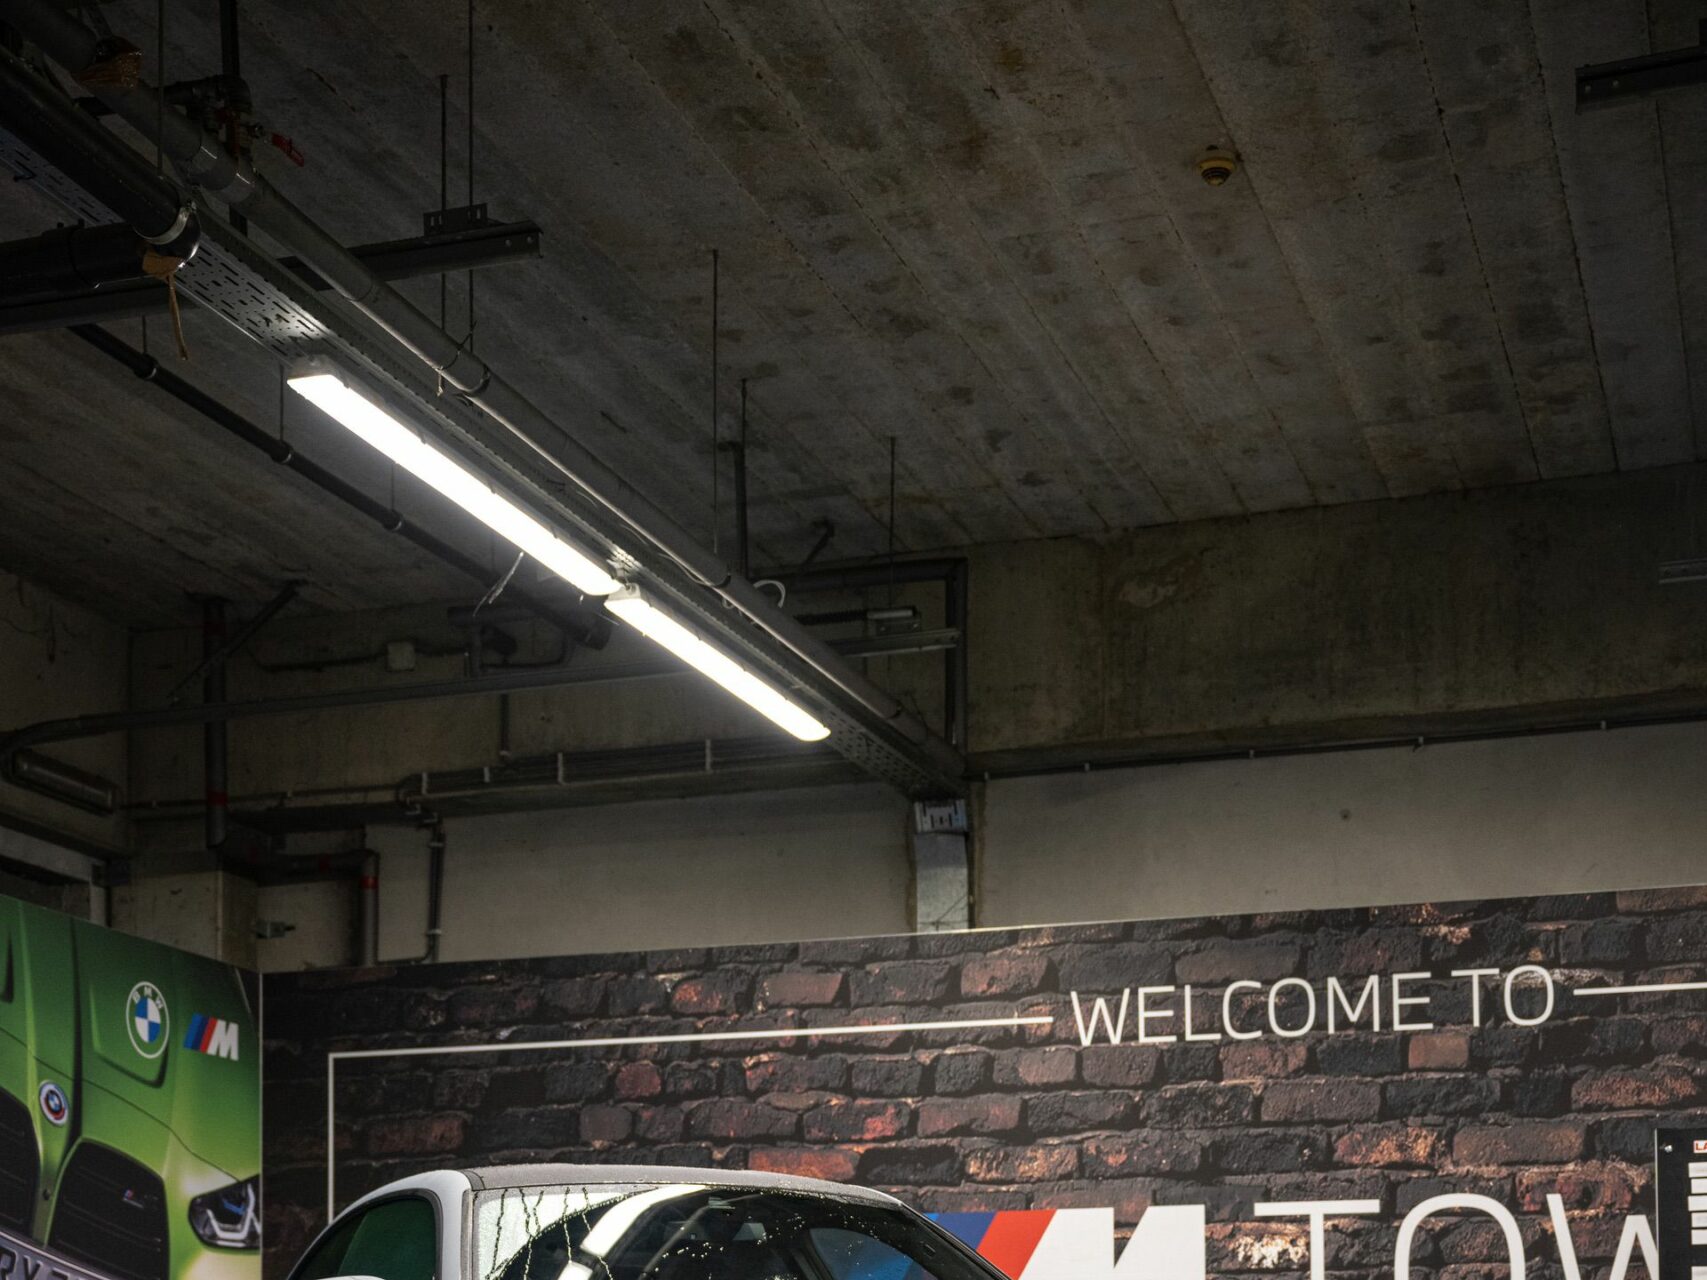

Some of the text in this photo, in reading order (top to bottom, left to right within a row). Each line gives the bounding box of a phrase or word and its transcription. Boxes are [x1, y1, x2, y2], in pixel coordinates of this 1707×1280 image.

[1070, 964, 1555, 1047] WELCOME TO
[206, 1017, 240, 1061] M
